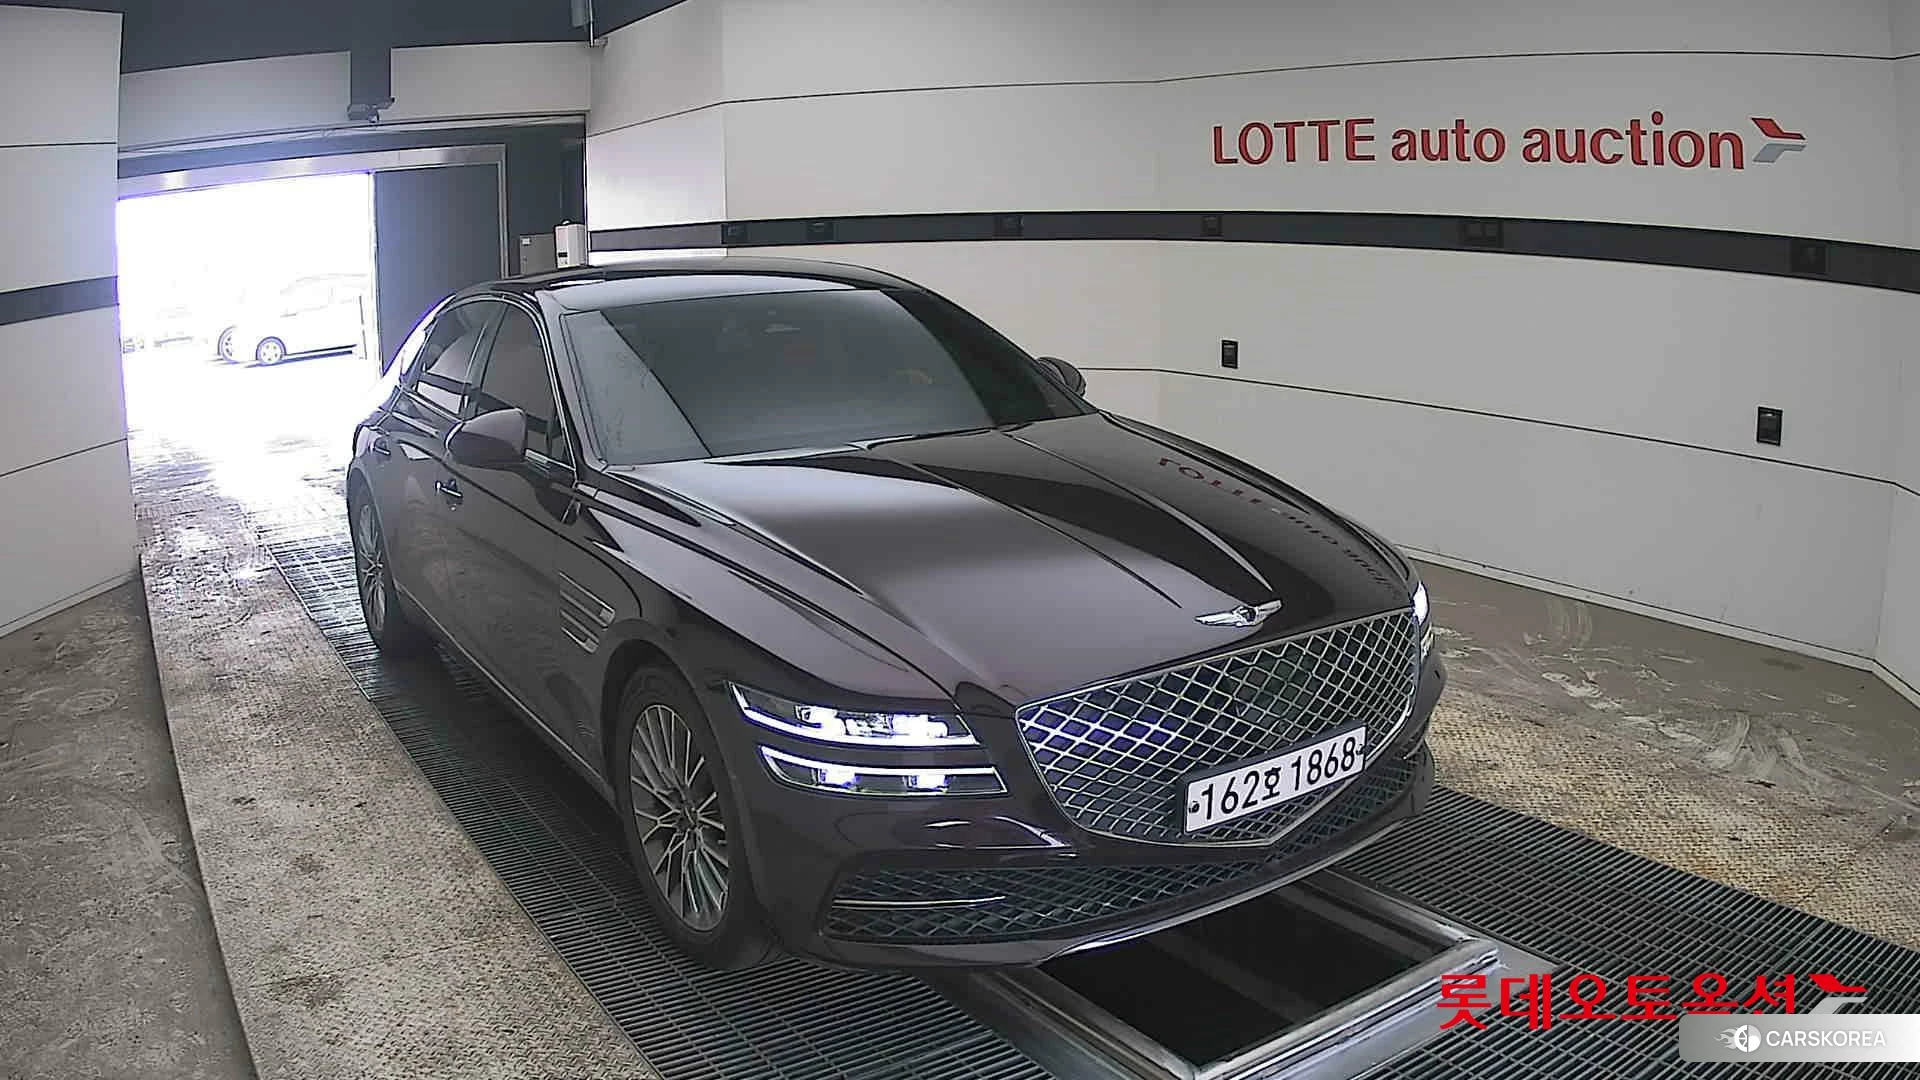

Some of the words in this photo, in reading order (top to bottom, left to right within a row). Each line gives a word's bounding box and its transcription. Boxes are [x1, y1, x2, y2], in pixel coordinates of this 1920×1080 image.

[1212, 117, 1376, 165] LOTTE
[1391, 118, 1507, 162] auto
[1522, 111, 1745, 170] auction
[1201, 766, 1282, 820] 162호
[1291, 736, 1356, 791] 1868
